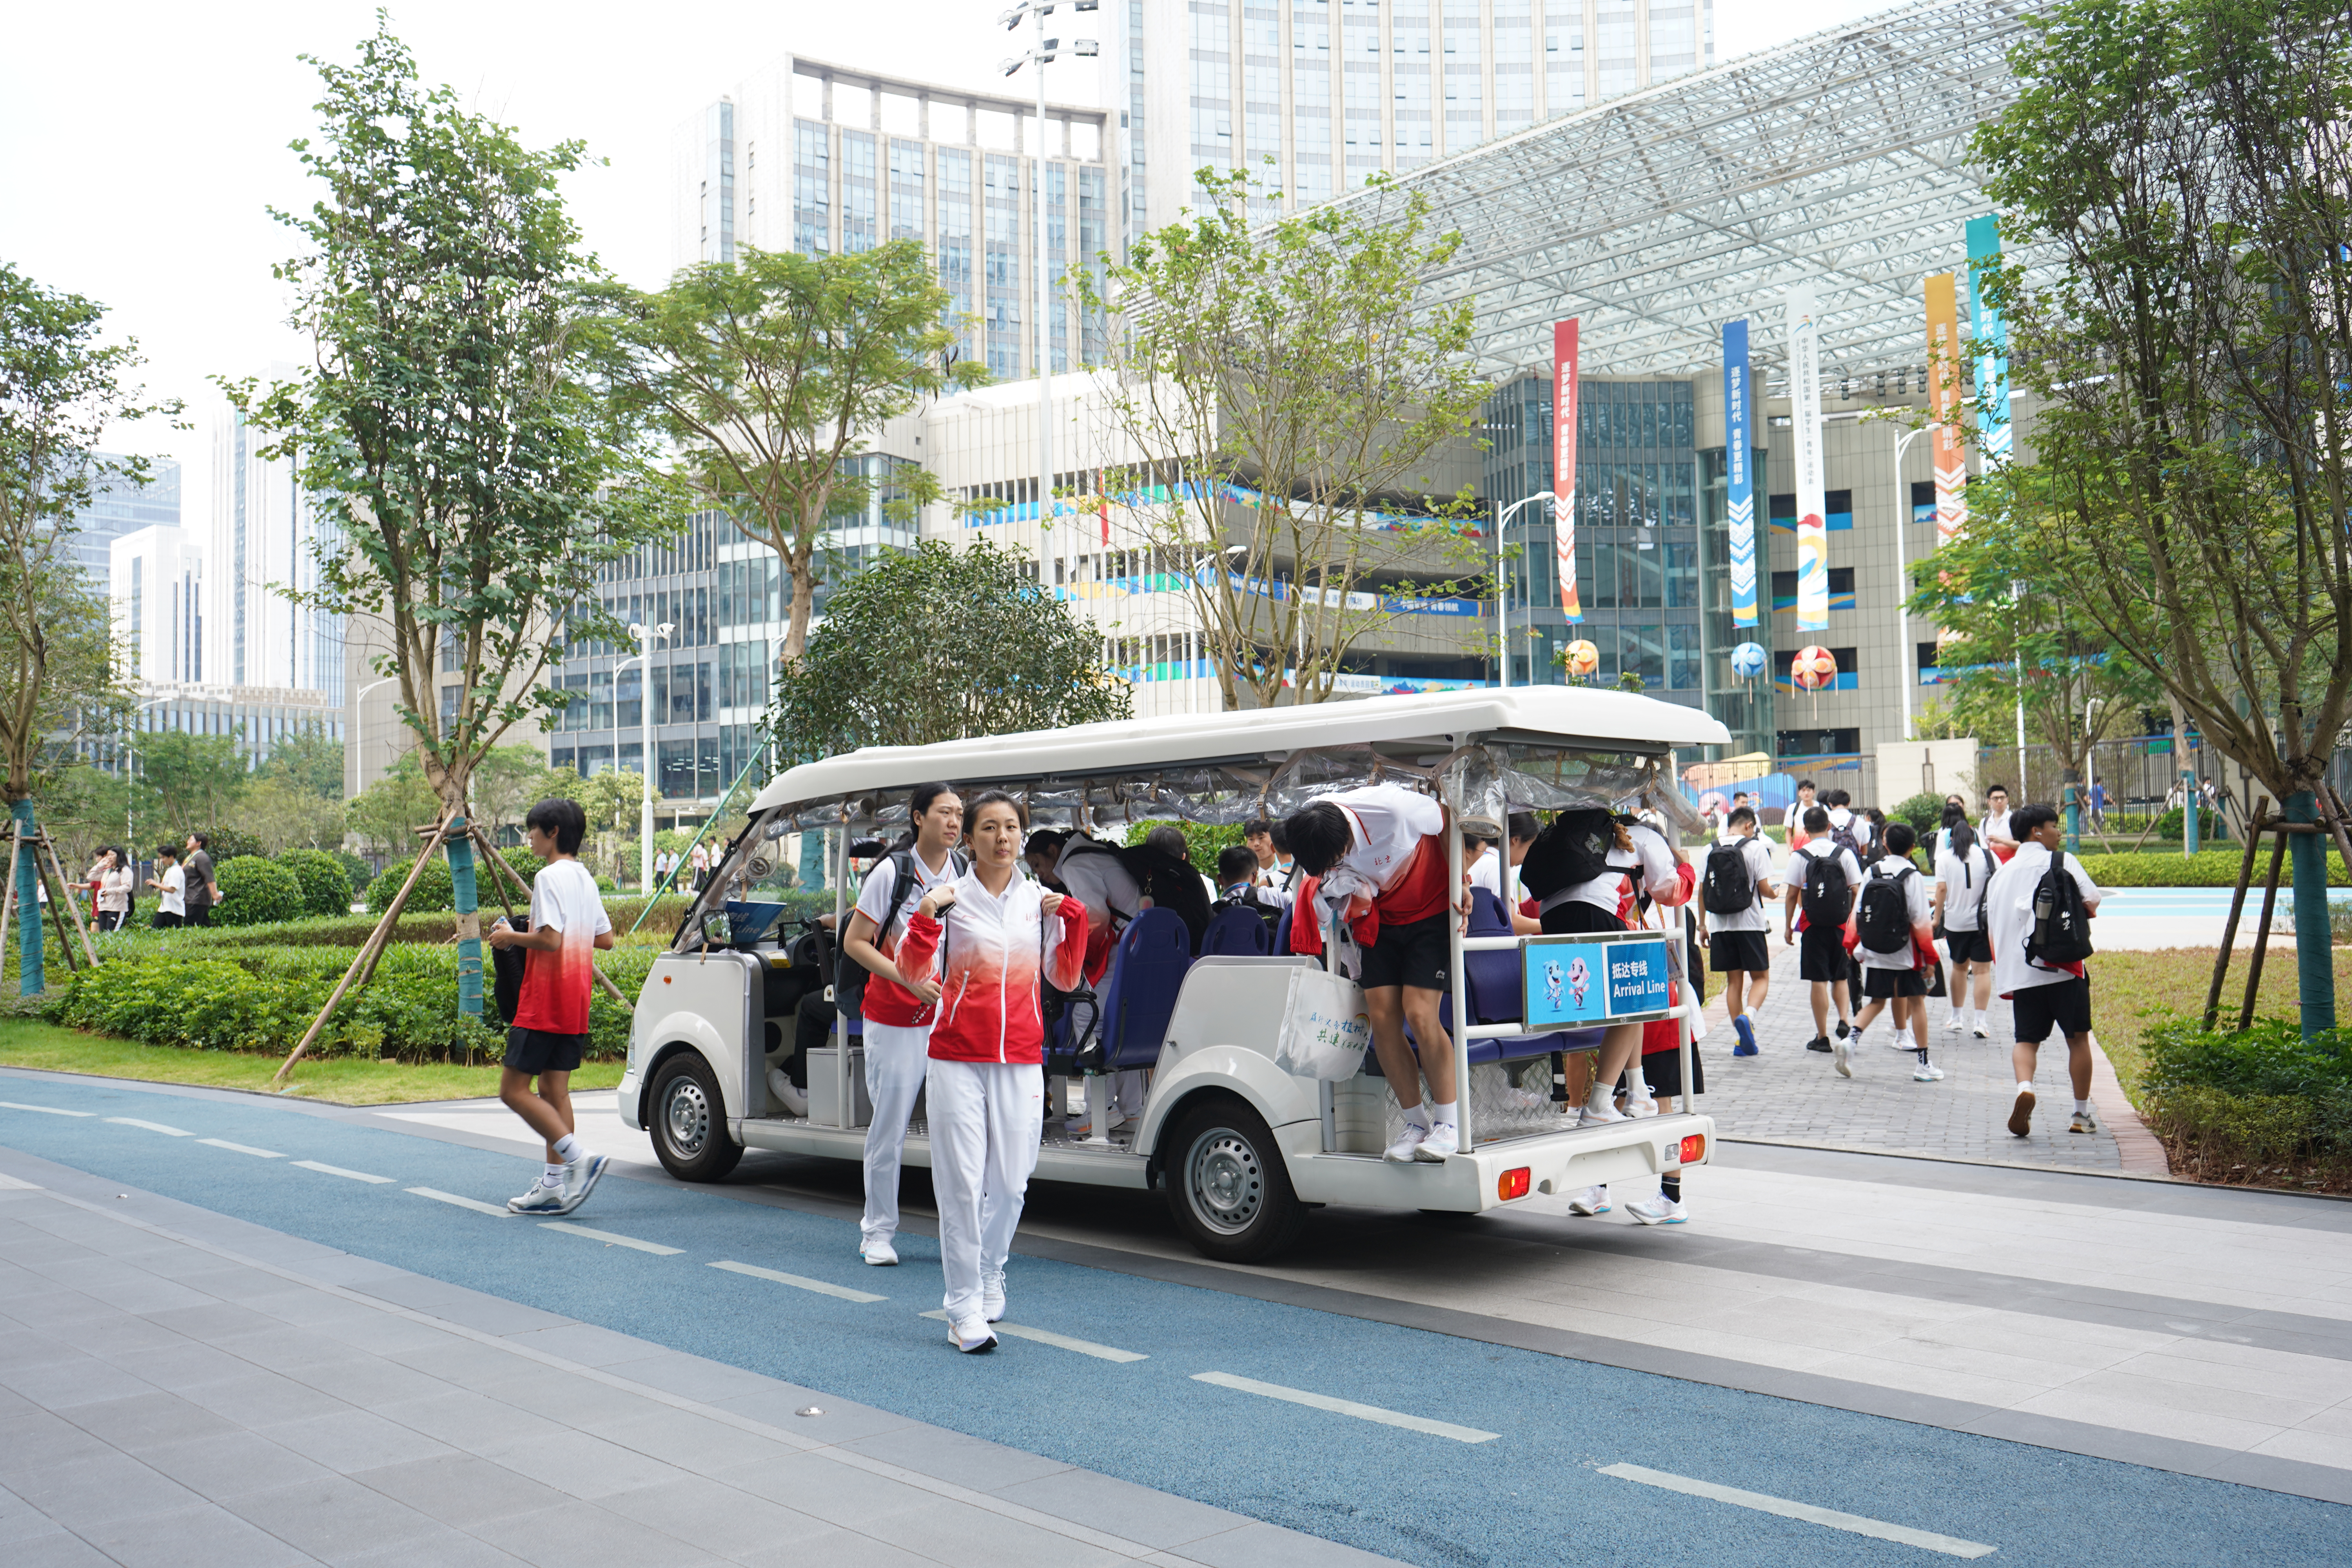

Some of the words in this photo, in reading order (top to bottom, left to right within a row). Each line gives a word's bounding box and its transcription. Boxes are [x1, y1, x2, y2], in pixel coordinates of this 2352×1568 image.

[1561, 361, 1571, 419] 逐梦新时代
[1731, 366, 1742, 423] 逐梦新时代
[1559, 424, 1570, 481] 青春更精彩
[1733, 428, 1743, 485] 青春更精彩
[1375, 855, 1391, 866] 北京
[735, 925, 760, 934] Line
[2061, 911, 2071, 931] 北京
[1612, 960, 1648, 980] 抵达专线
[1613, 983, 1644, 998] Arrival
[1647, 980, 1665, 995] Line
